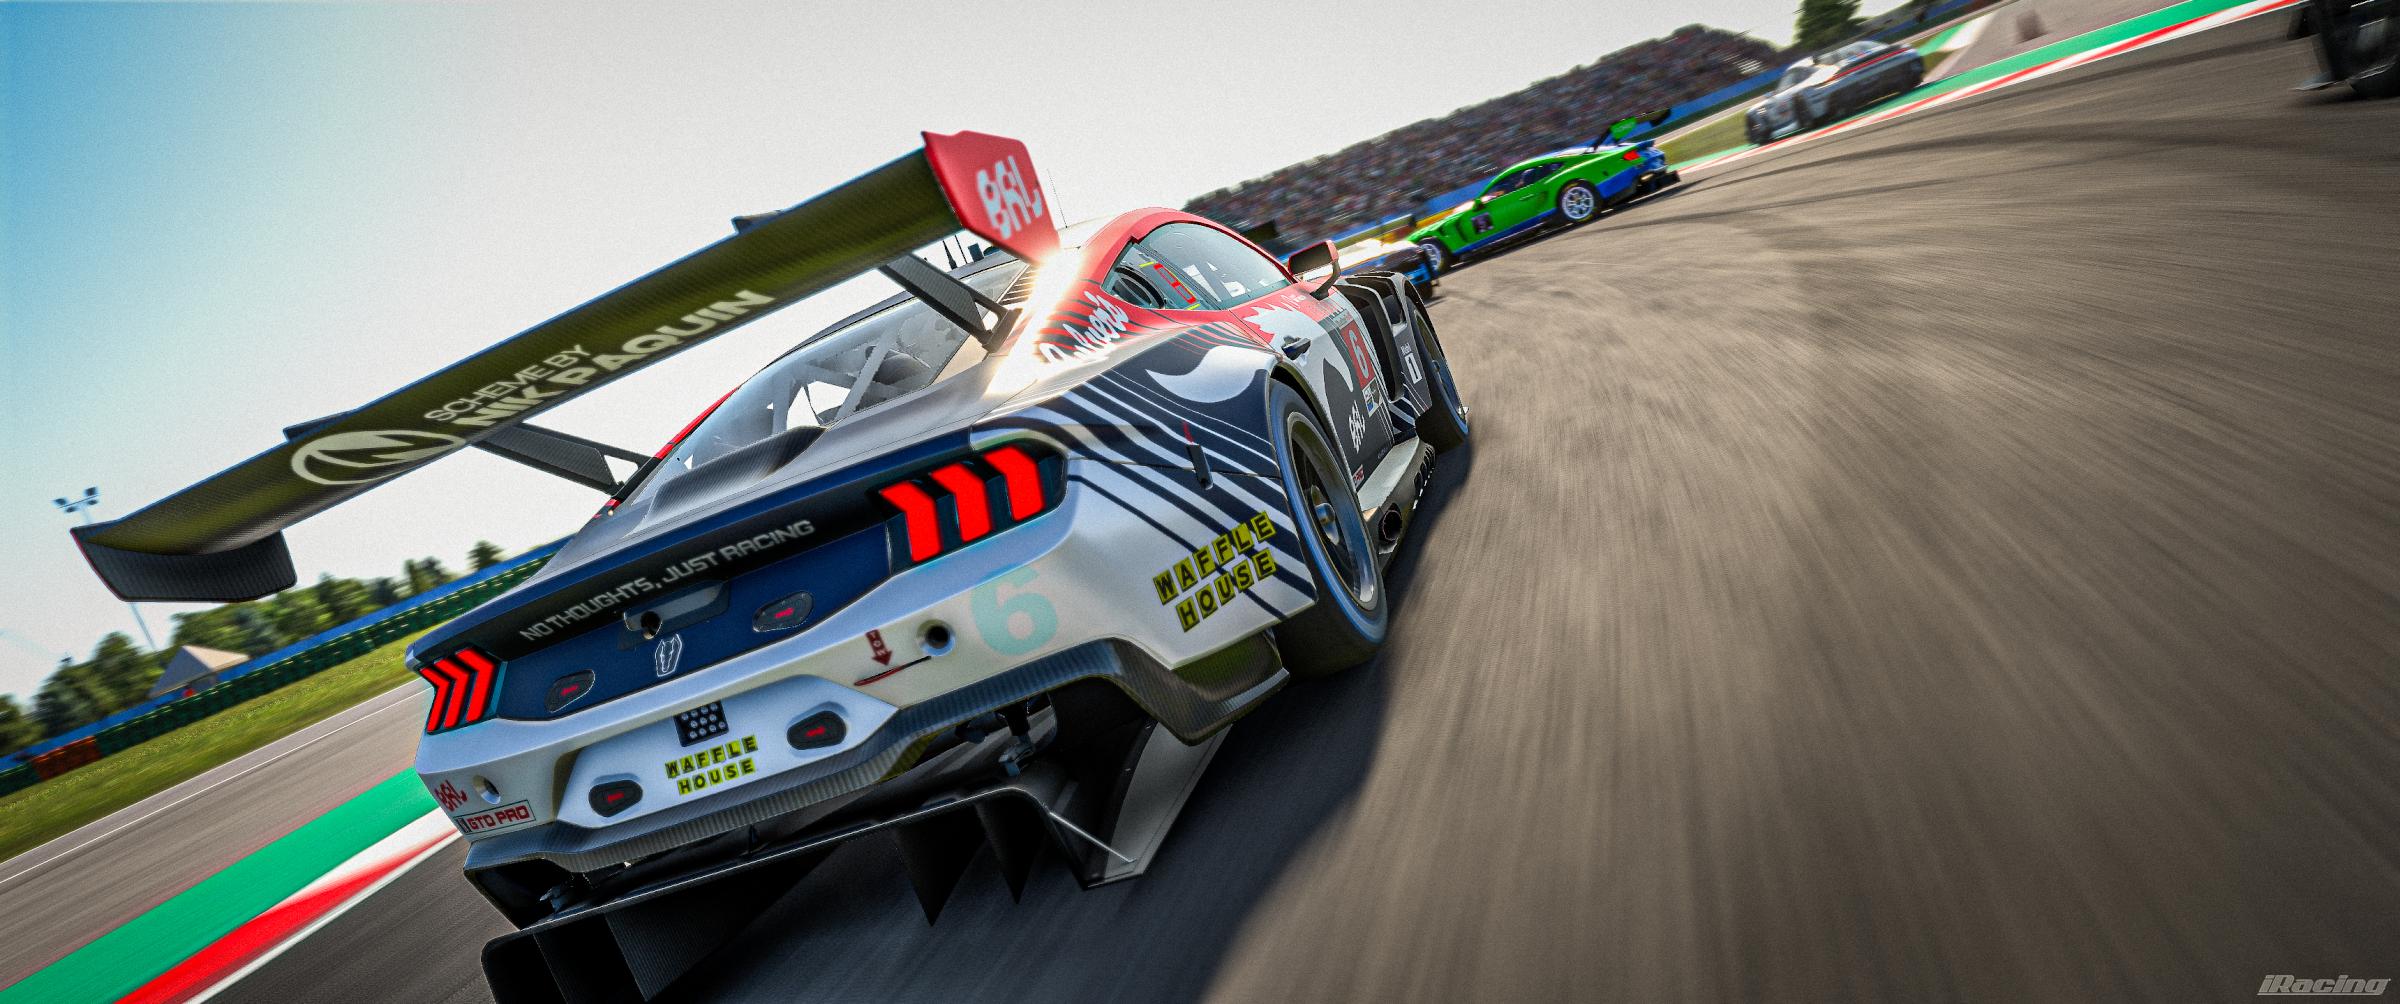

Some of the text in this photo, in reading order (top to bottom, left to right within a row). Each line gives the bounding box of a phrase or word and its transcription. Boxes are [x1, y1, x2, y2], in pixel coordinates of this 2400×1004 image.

[424, 344, 591, 422] SCHEME BY
[451, 289, 775, 426] NIK PAQUIN
[1348, 329, 1369, 379] 6
[520, 519, 816, 641] NO THOUGHTS, JUST RACING
[1153, 511, 1277, 605] WAFFLE
[1176, 548, 1277, 632] HOUSE
[972, 563, 1058, 656] 6
[665, 735, 758, 778] WAFFLE
[677, 757, 756, 795] HOUSE
[495, 805, 530, 825] PRO
